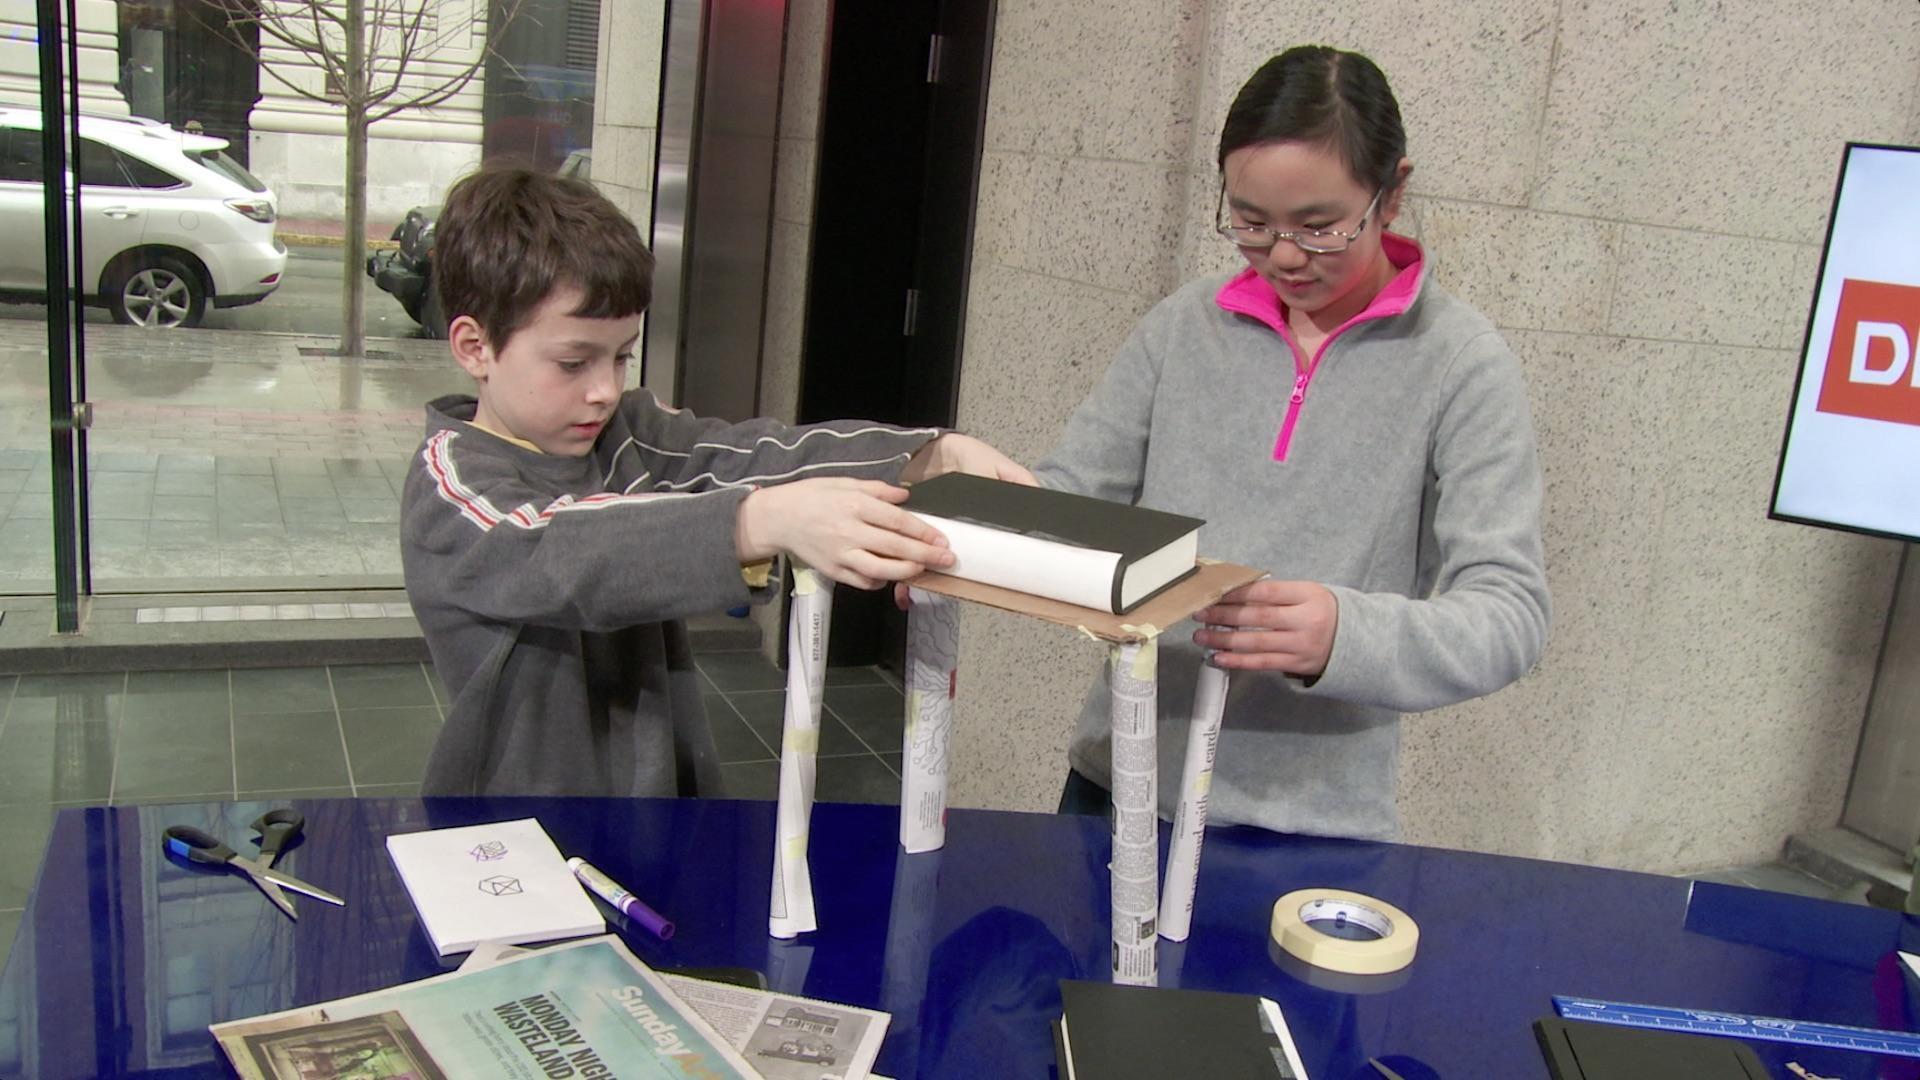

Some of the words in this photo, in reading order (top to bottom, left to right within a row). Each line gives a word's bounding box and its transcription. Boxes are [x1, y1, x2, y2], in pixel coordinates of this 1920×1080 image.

[1848, 320, 1920, 388] D
[1196, 795, 1208, 827] with
[1203, 724, 1218, 764] cards
[493, 1000, 575, 1080] WASTELAND
[519, 993, 587, 1046] MONDAY
